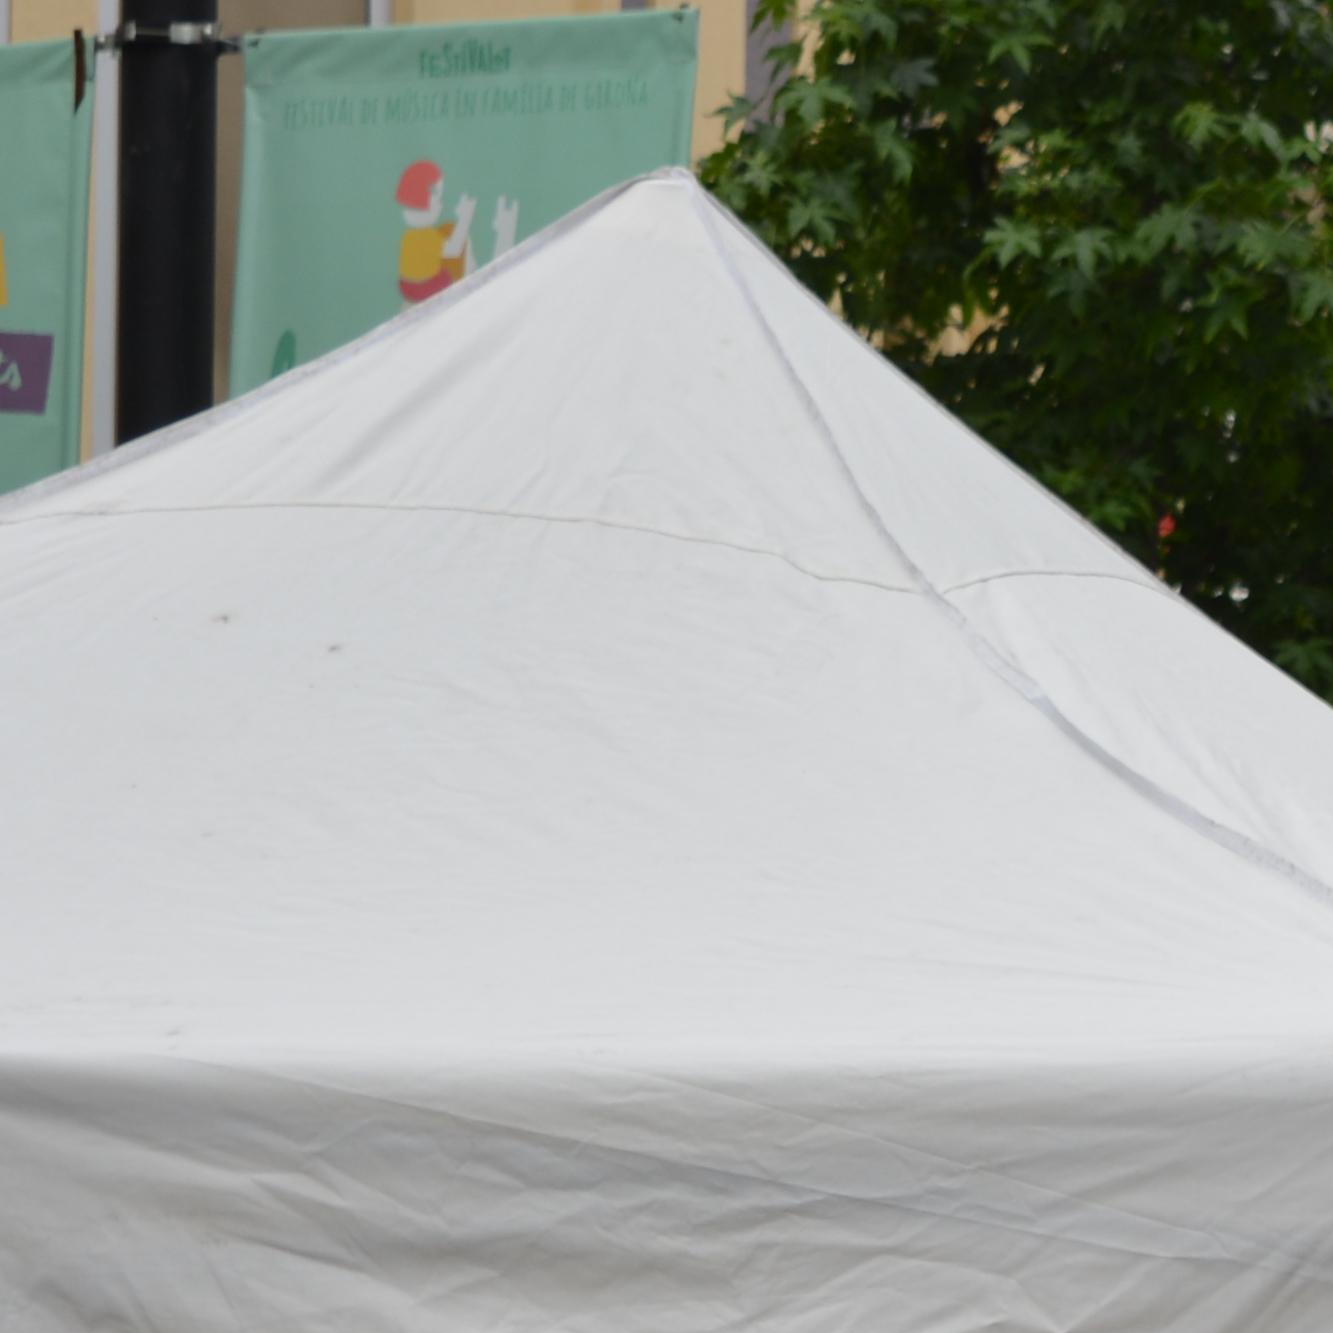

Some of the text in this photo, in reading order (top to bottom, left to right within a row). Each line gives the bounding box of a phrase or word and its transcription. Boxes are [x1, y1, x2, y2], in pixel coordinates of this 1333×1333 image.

[283, 95, 353, 131] FESTIVAL
[359, 96, 379, 126] DE
[558, 82, 577, 112] DE
